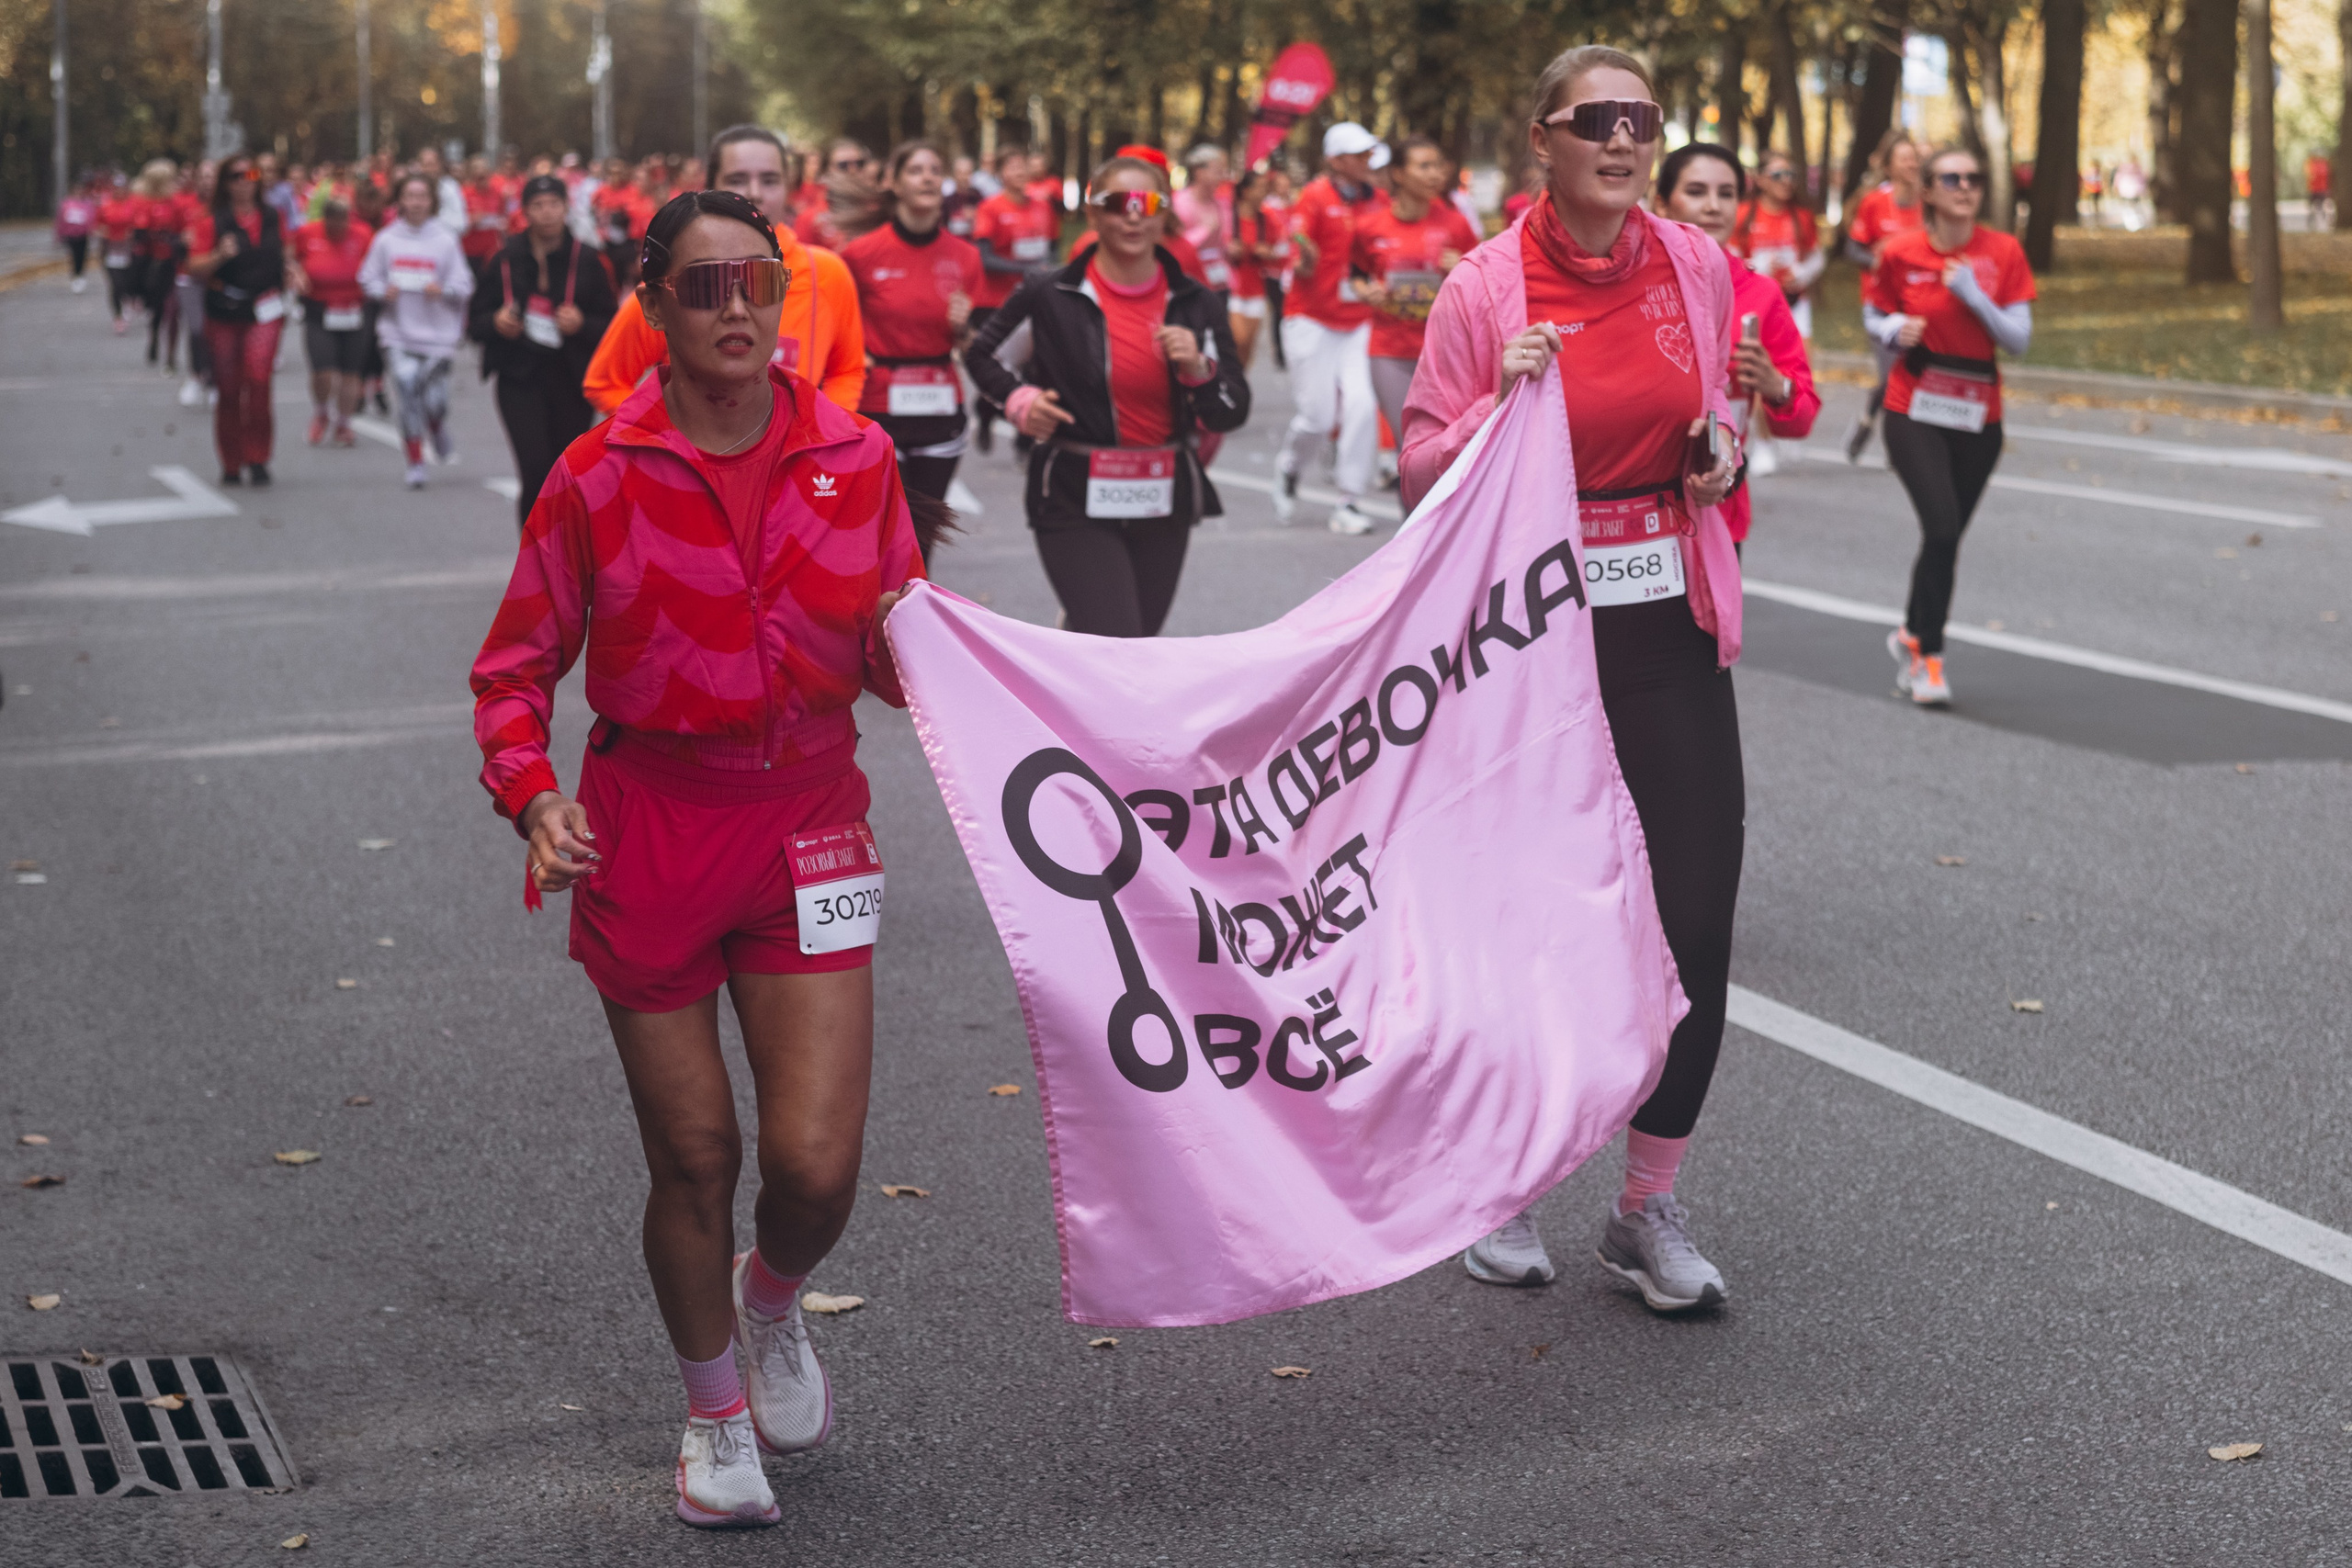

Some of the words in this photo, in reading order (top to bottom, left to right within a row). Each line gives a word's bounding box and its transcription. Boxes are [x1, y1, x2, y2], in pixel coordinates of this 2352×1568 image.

[1555, 322, 1585, 335] порт
[1585, 553, 1662, 582] 0568
[1644, 588, 1650, 598] 3
[1123, 776, 1280, 858] ЭТА
[1267, 538, 1588, 832] ДЕВОЧКА
[796, 849, 838, 875] РОЗОВЫЙ
[834, 846, 856, 867] ЗАБЕГ
[814, 888, 882, 925] 30219
[1189, 832, 1378, 978] МОЖЕТ
[1193, 987, 1373, 1092] ВСЁ
